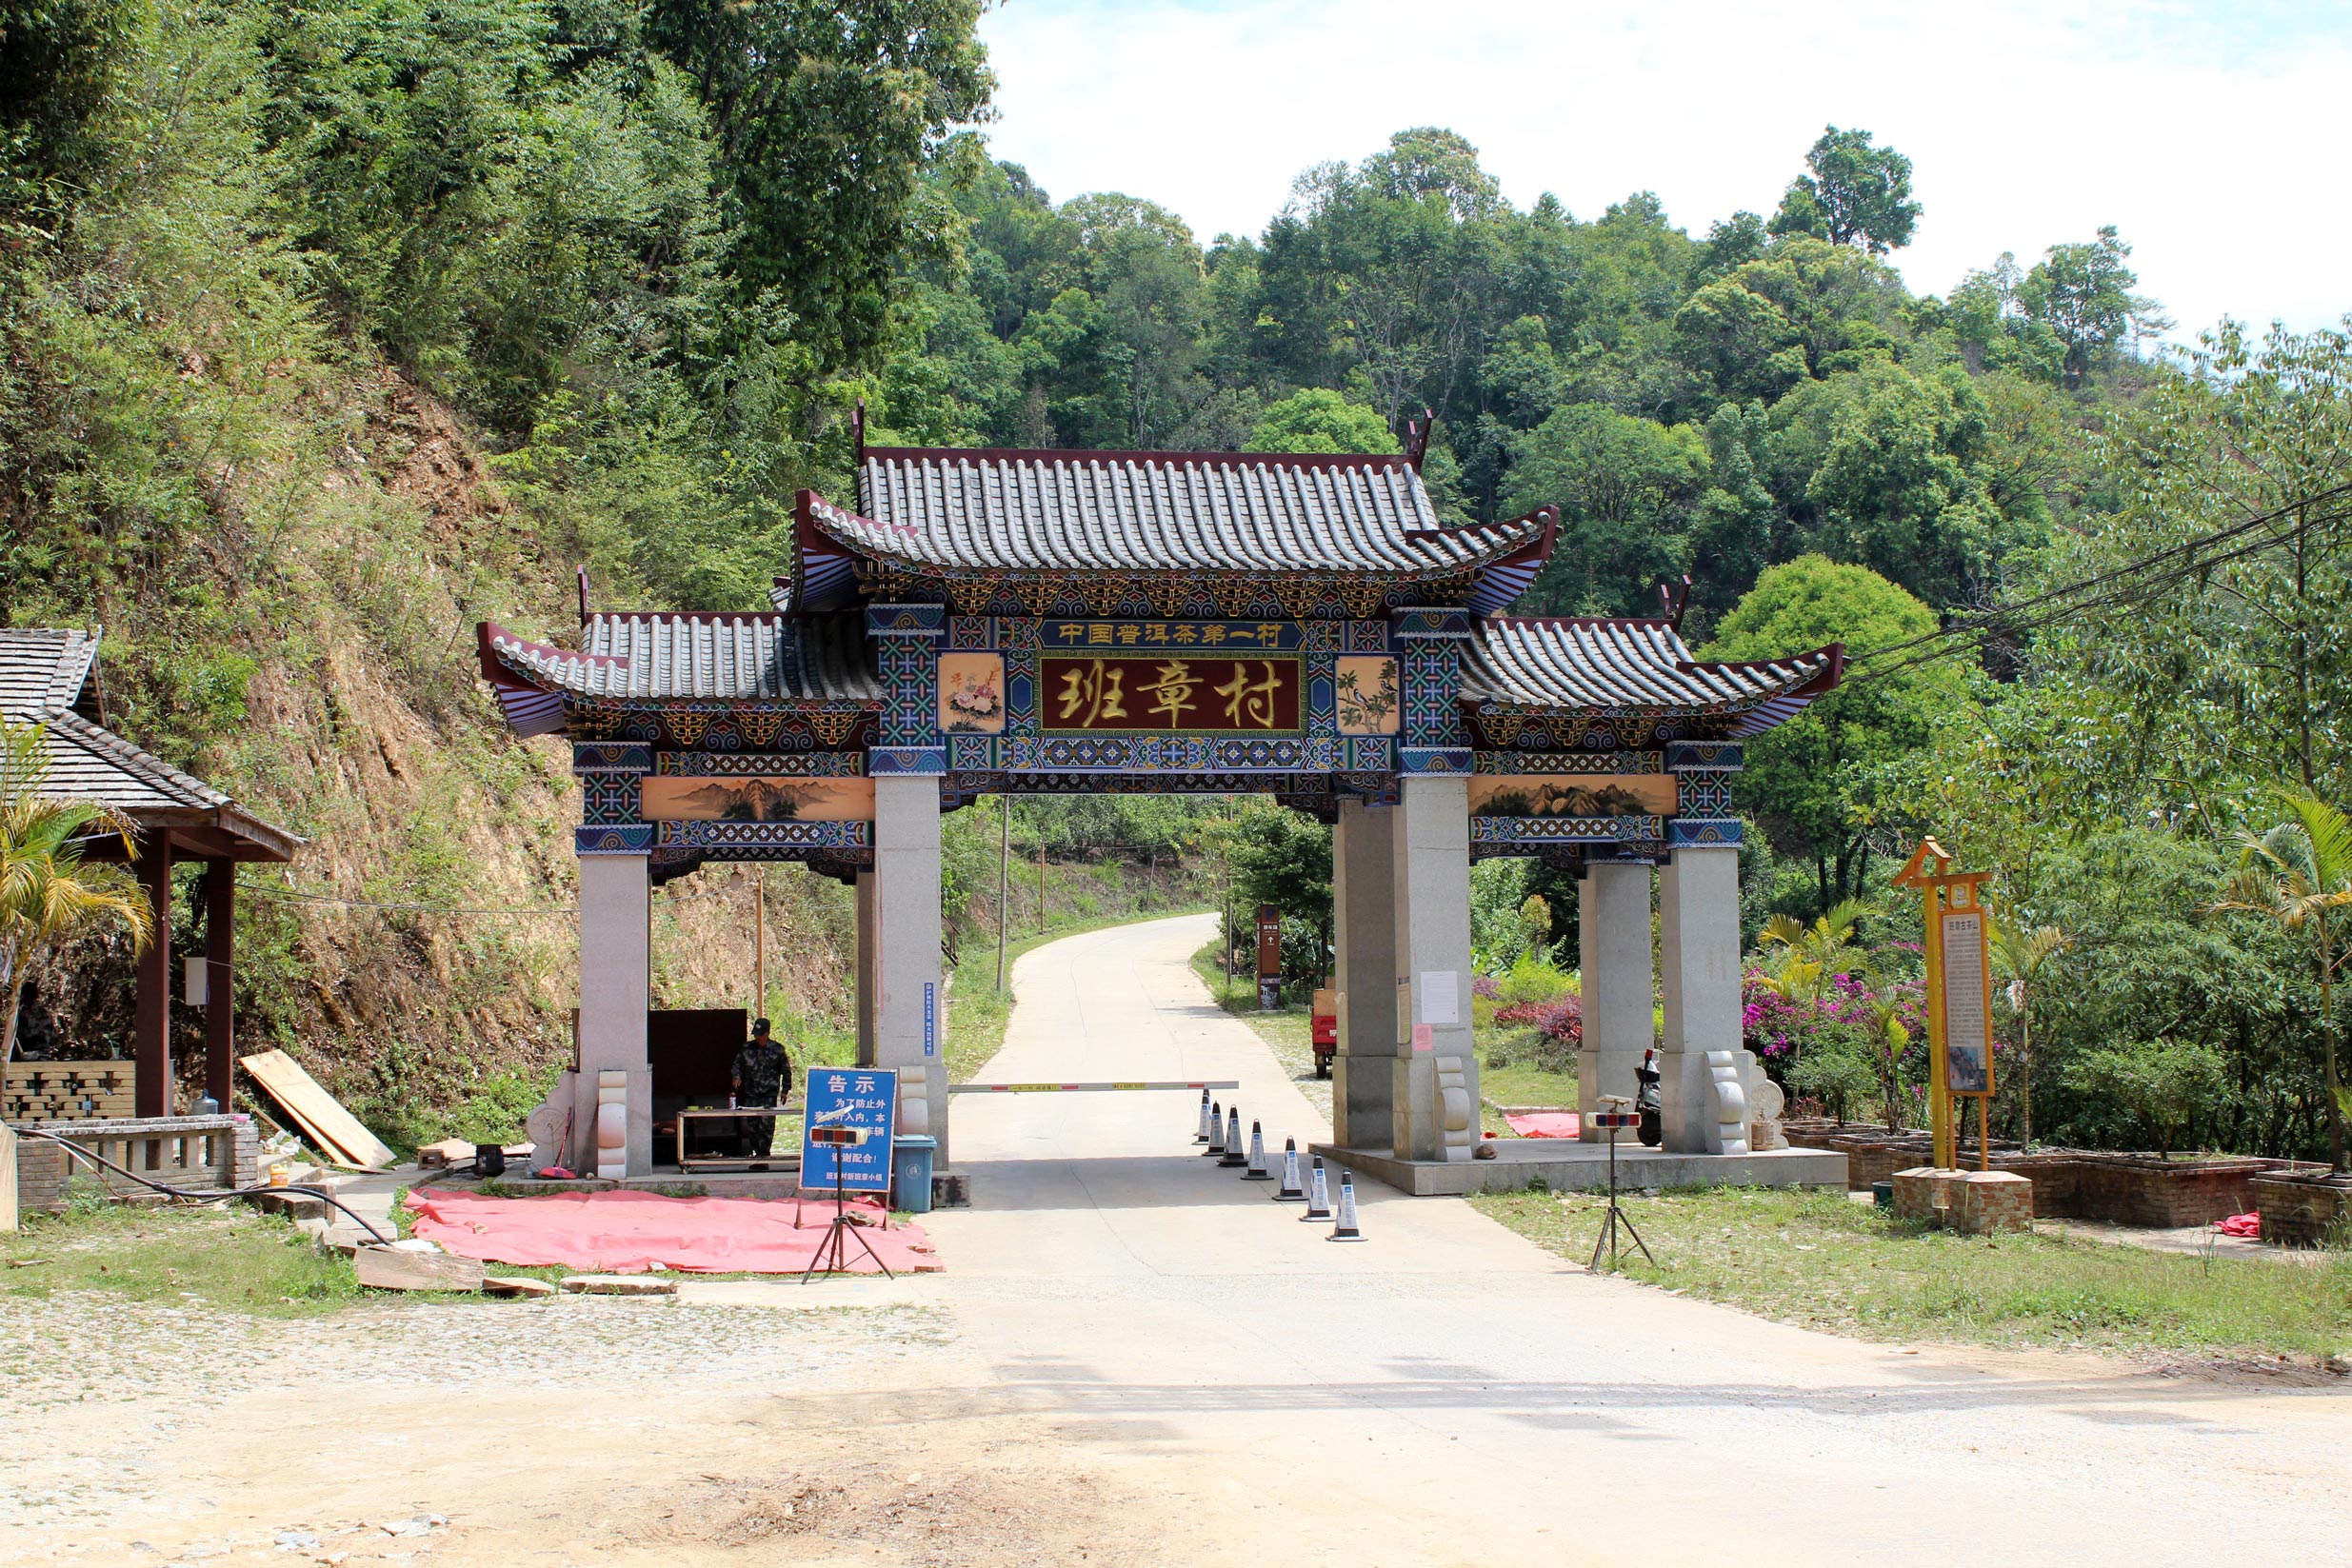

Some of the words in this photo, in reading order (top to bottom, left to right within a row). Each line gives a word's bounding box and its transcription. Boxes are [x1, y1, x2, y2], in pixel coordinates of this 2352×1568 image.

[1059, 623, 1283, 647] 中国普洱茶第一村
[1058, 657, 1283, 728] 班章村
[827, 1074, 875, 1094] 告示
[835, 1098, 886, 1109] 为了防止外
